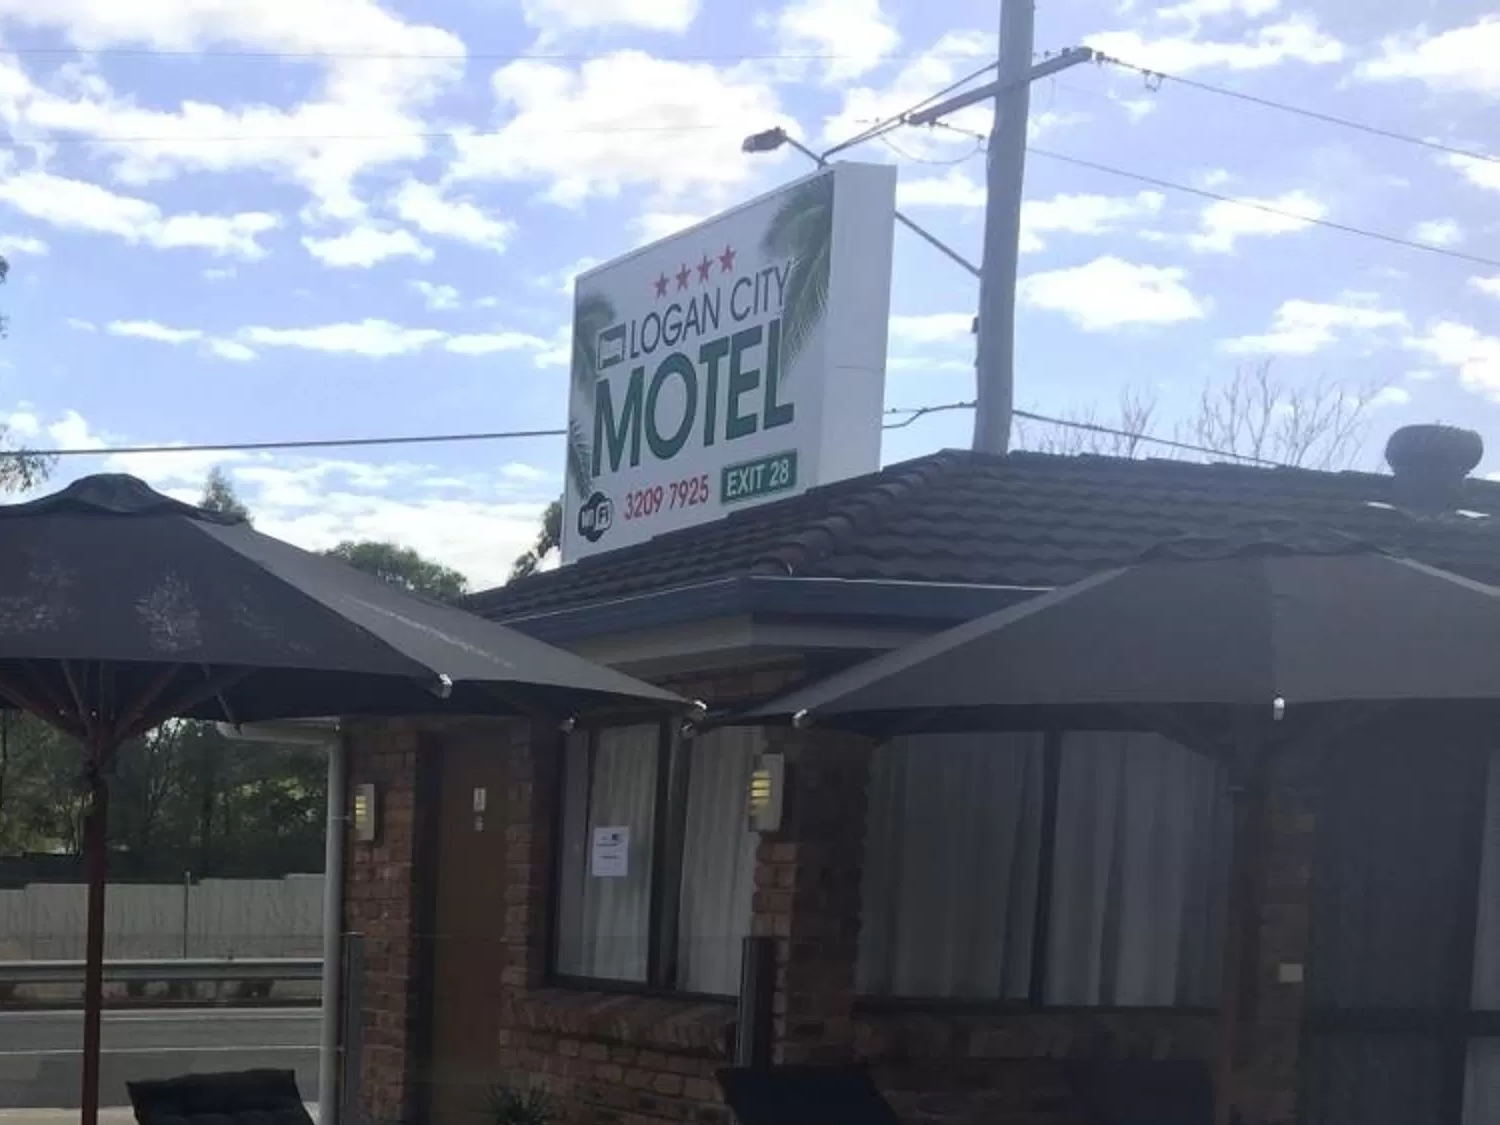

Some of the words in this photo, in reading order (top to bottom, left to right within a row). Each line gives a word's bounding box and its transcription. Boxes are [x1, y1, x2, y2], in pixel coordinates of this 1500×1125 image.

[629, 288, 721, 359] LOGAN
[730, 260, 792, 322] CITY
[592, 318, 795, 478] MOTEL
[624, 485, 663, 520] 3209
[668, 474, 710, 512] 7925
[726, 464, 765, 497] EXIT
[769, 459, 790, 487] 28
